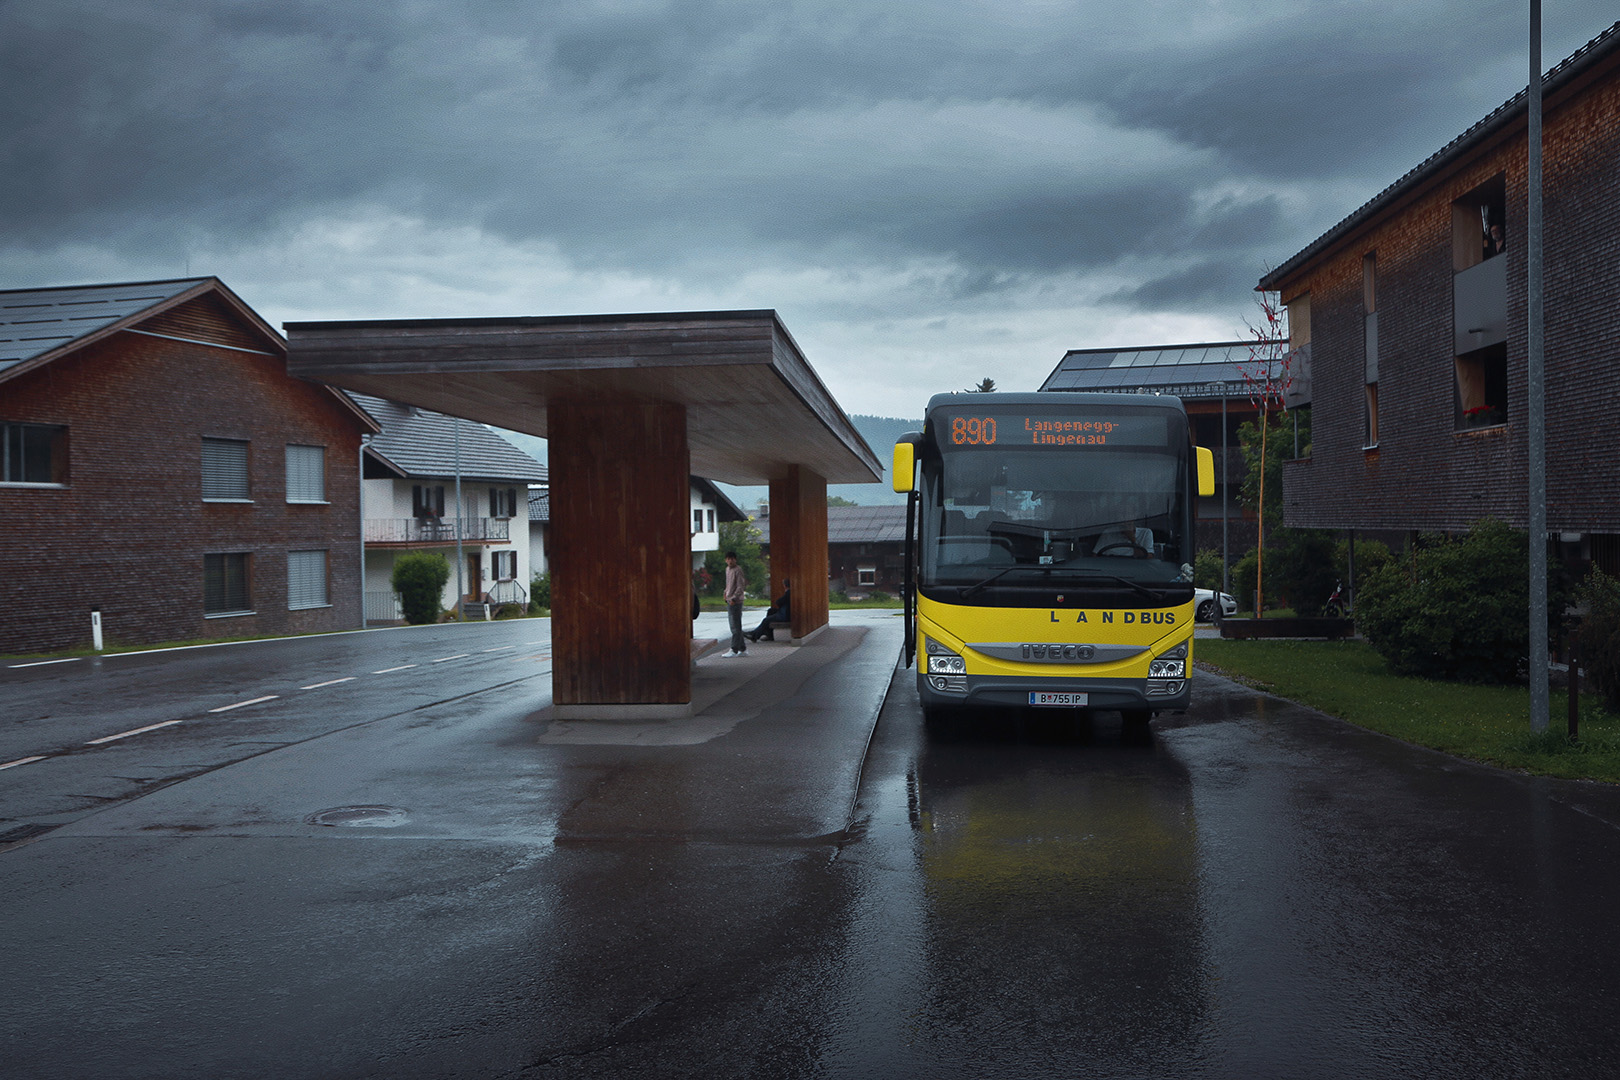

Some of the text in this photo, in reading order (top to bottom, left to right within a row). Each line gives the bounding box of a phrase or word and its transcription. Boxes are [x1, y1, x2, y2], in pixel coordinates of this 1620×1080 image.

[952, 417, 997, 445] 890
[1024, 418, 1119, 433] Langenegg-
[1033, 431, 1106, 446] Lingenau
[1050, 611, 1176, 625] LANDBUS
[1022, 644, 1095, 660] IVECO
